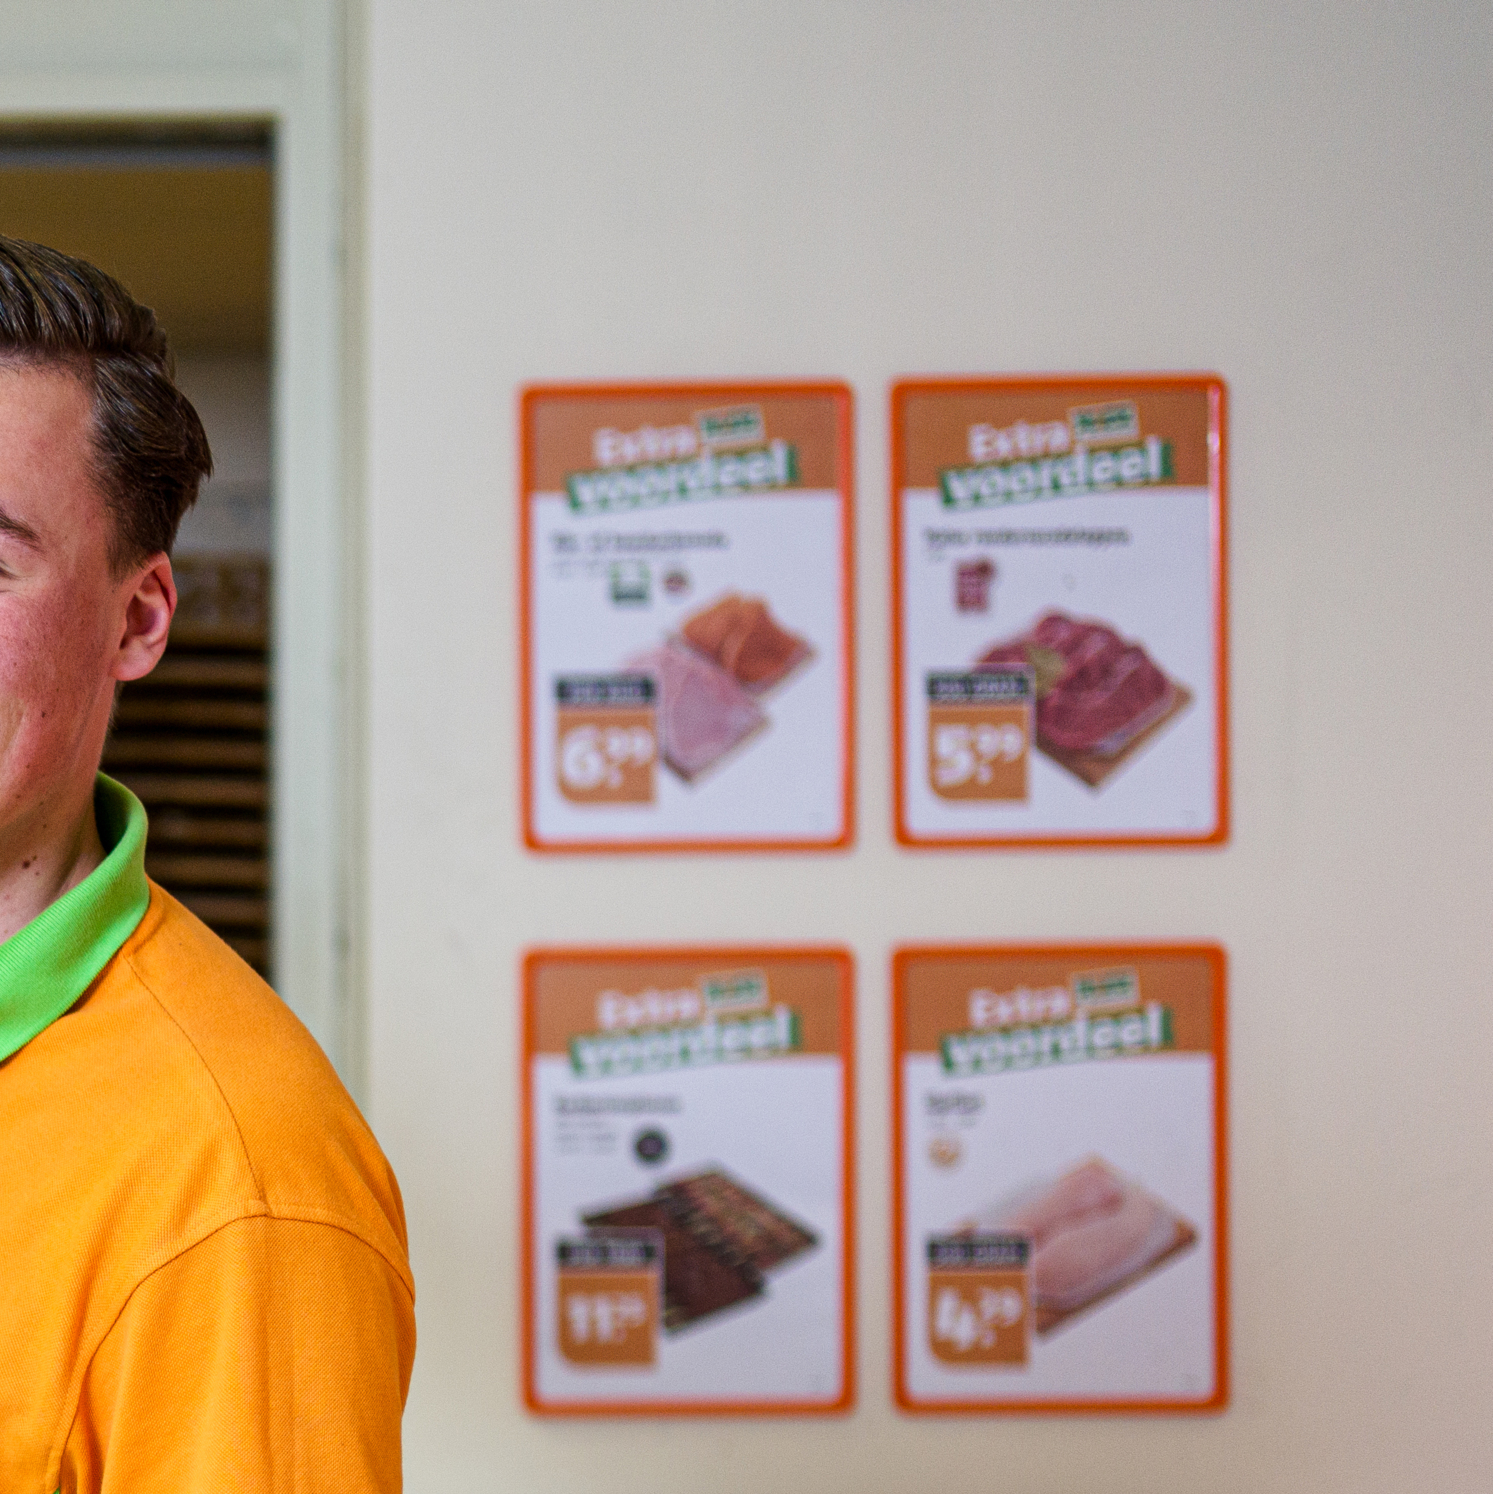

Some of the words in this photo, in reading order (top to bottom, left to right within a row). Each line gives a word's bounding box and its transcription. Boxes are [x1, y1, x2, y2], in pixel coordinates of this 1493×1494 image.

[593, 424, 697, 465] Extra
[968, 420, 1070, 462] Extra
[945, 434, 1162, 505] voordeel
[969, 986, 1070, 1029] Extra
